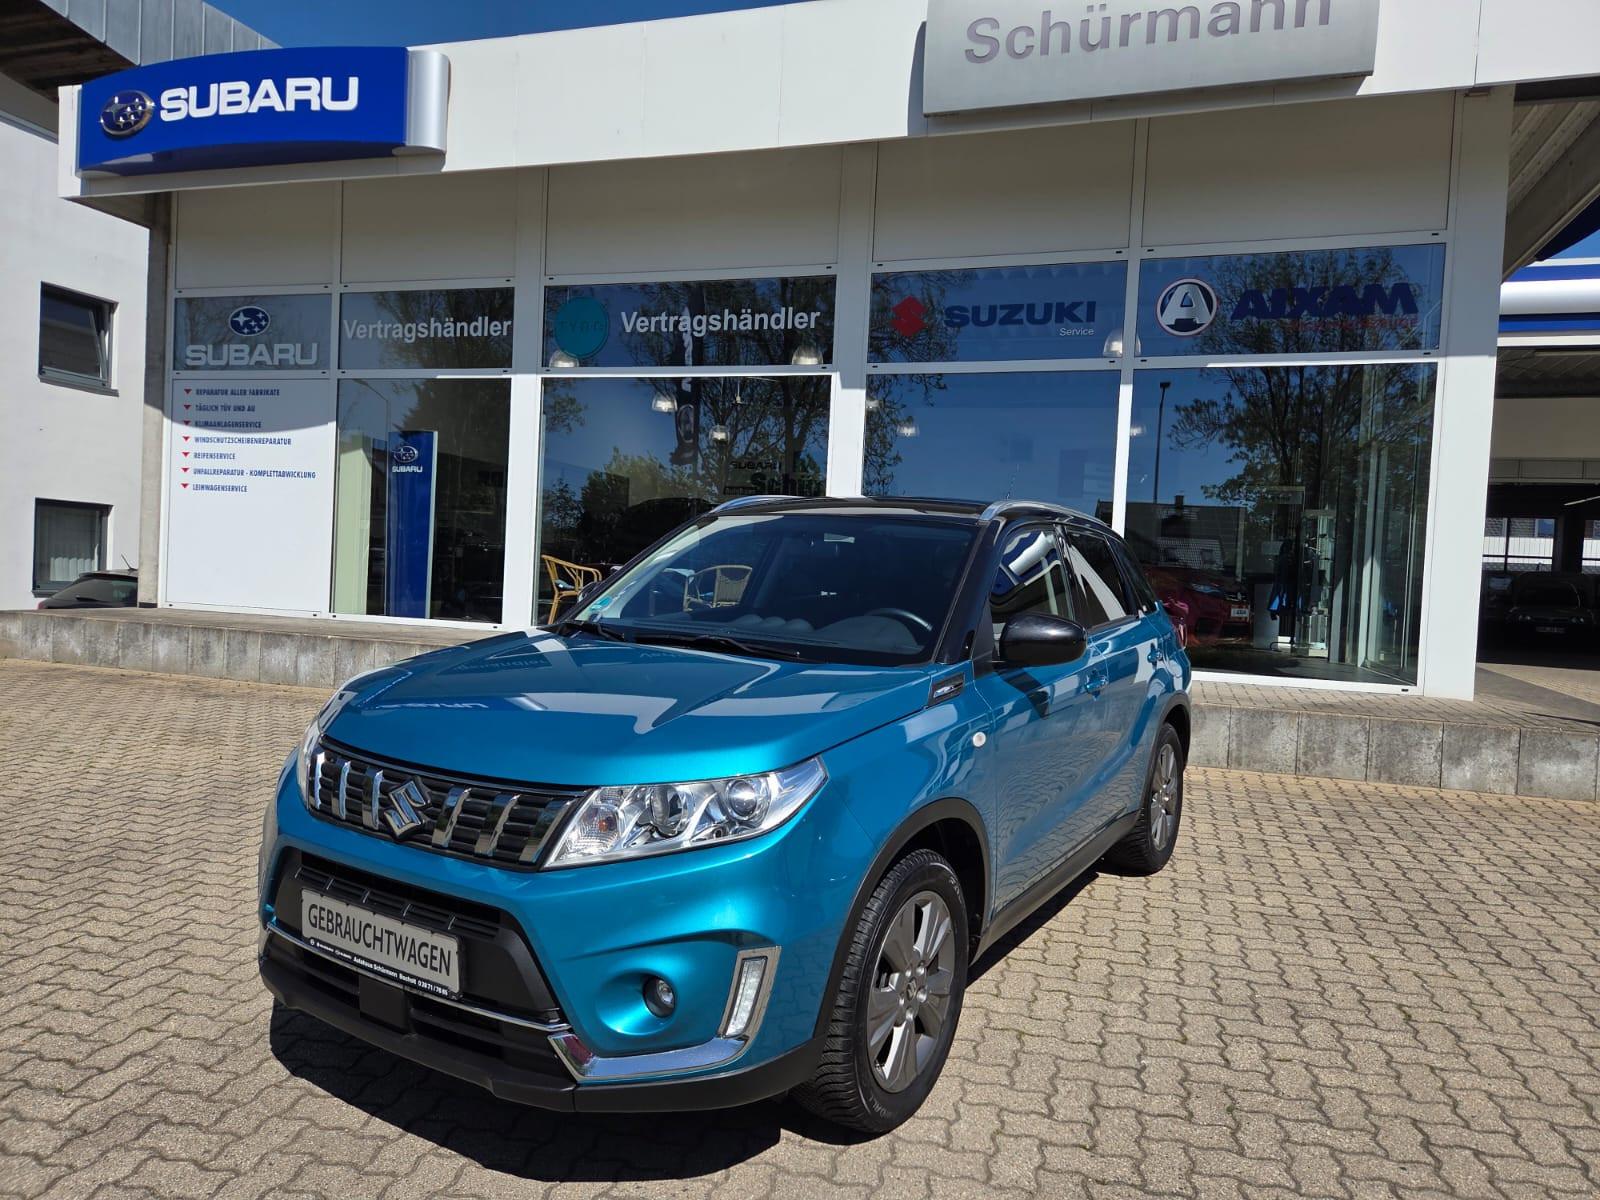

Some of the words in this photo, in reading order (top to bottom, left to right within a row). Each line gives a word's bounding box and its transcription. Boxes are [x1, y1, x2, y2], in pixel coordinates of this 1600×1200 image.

[964, 0, 1331, 64] Schürmann
[159, 76, 360, 122] SUBARU
[1230, 282, 1420, 321] AIXAM
[943, 301, 1097, 328] SUZUKI
[620, 306, 821, 338] Vertragshändler
[343, 316, 513, 344] Vertragshändler
[1059, 327, 1095, 337] Service
[185, 343, 318, 366] SUBARU
[195, 388, 229, 397] REPARATUR
[230, 388, 247, 397] ALLER
[249, 388, 280, 397] FABRIKATE
[195, 402, 219, 412] TÄGLICH
[220, 403, 233, 412] TÜV
[233, 404, 246, 412] UND
[247, 404, 256, 412] AU
[194, 420, 262, 429] KLIMAANLAGENSERVICE
[194, 435, 292, 445] WINDSCHUTZSCHEIBENREPARATUR
[193, 452, 236, 460] REIFENSERVICE
[193, 467, 245, 476] UNFALLREPARATUR
[249, 470, 316, 479] KOMPLETTABWICKLUNG
[391, 465, 423, 473] SUBARU
[192, 483, 248, 493] LEIHWAGENSERVICE
[308, 903, 452, 977] GEBRAUCHTWAGEN
